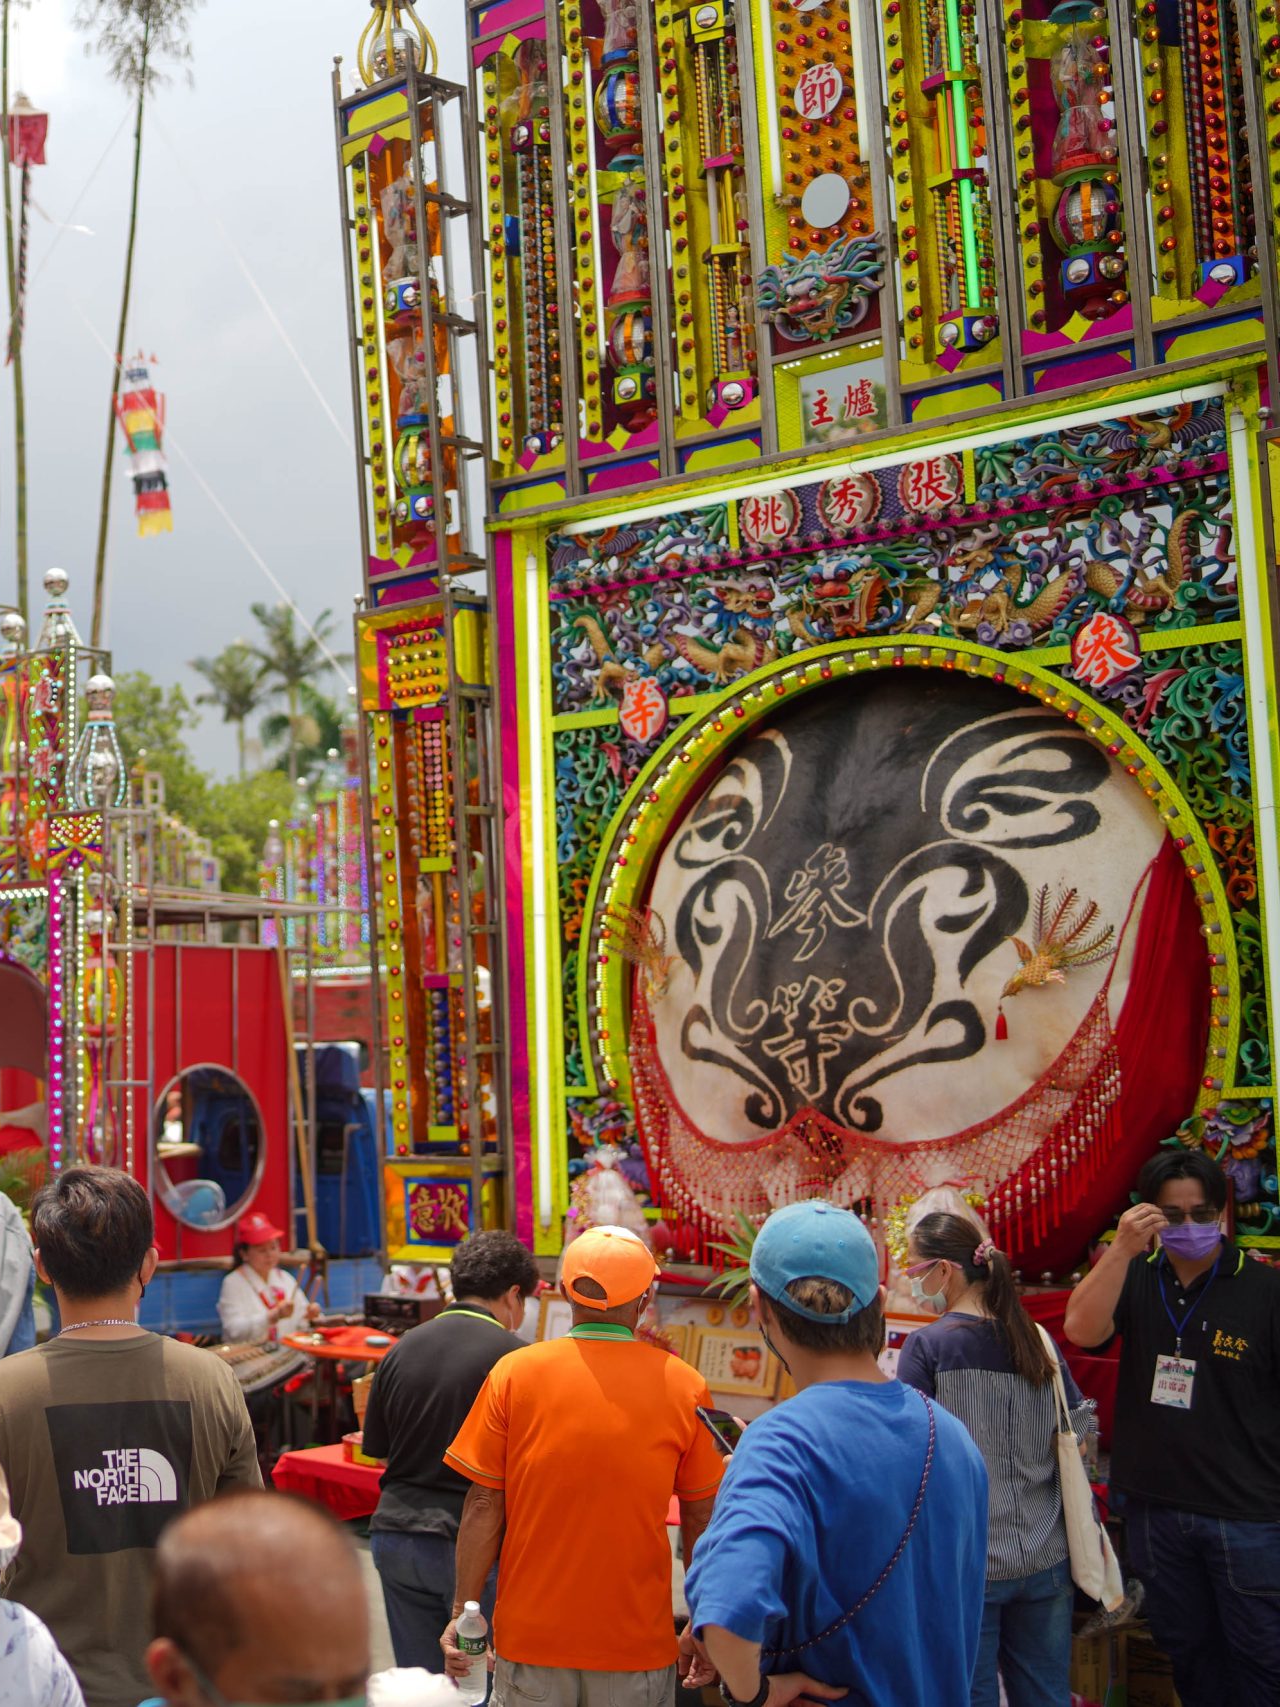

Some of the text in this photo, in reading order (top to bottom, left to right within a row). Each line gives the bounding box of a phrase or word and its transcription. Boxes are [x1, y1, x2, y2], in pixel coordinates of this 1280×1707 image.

[800, 63, 836, 116] 節
[810, 379, 879, 429] 爐主
[748, 457, 954, 540] 張秀桃
[102, 1448, 139, 1469] THE
[74, 1466, 139, 1489] NORTH
[96, 1483, 139, 1506] FACE
